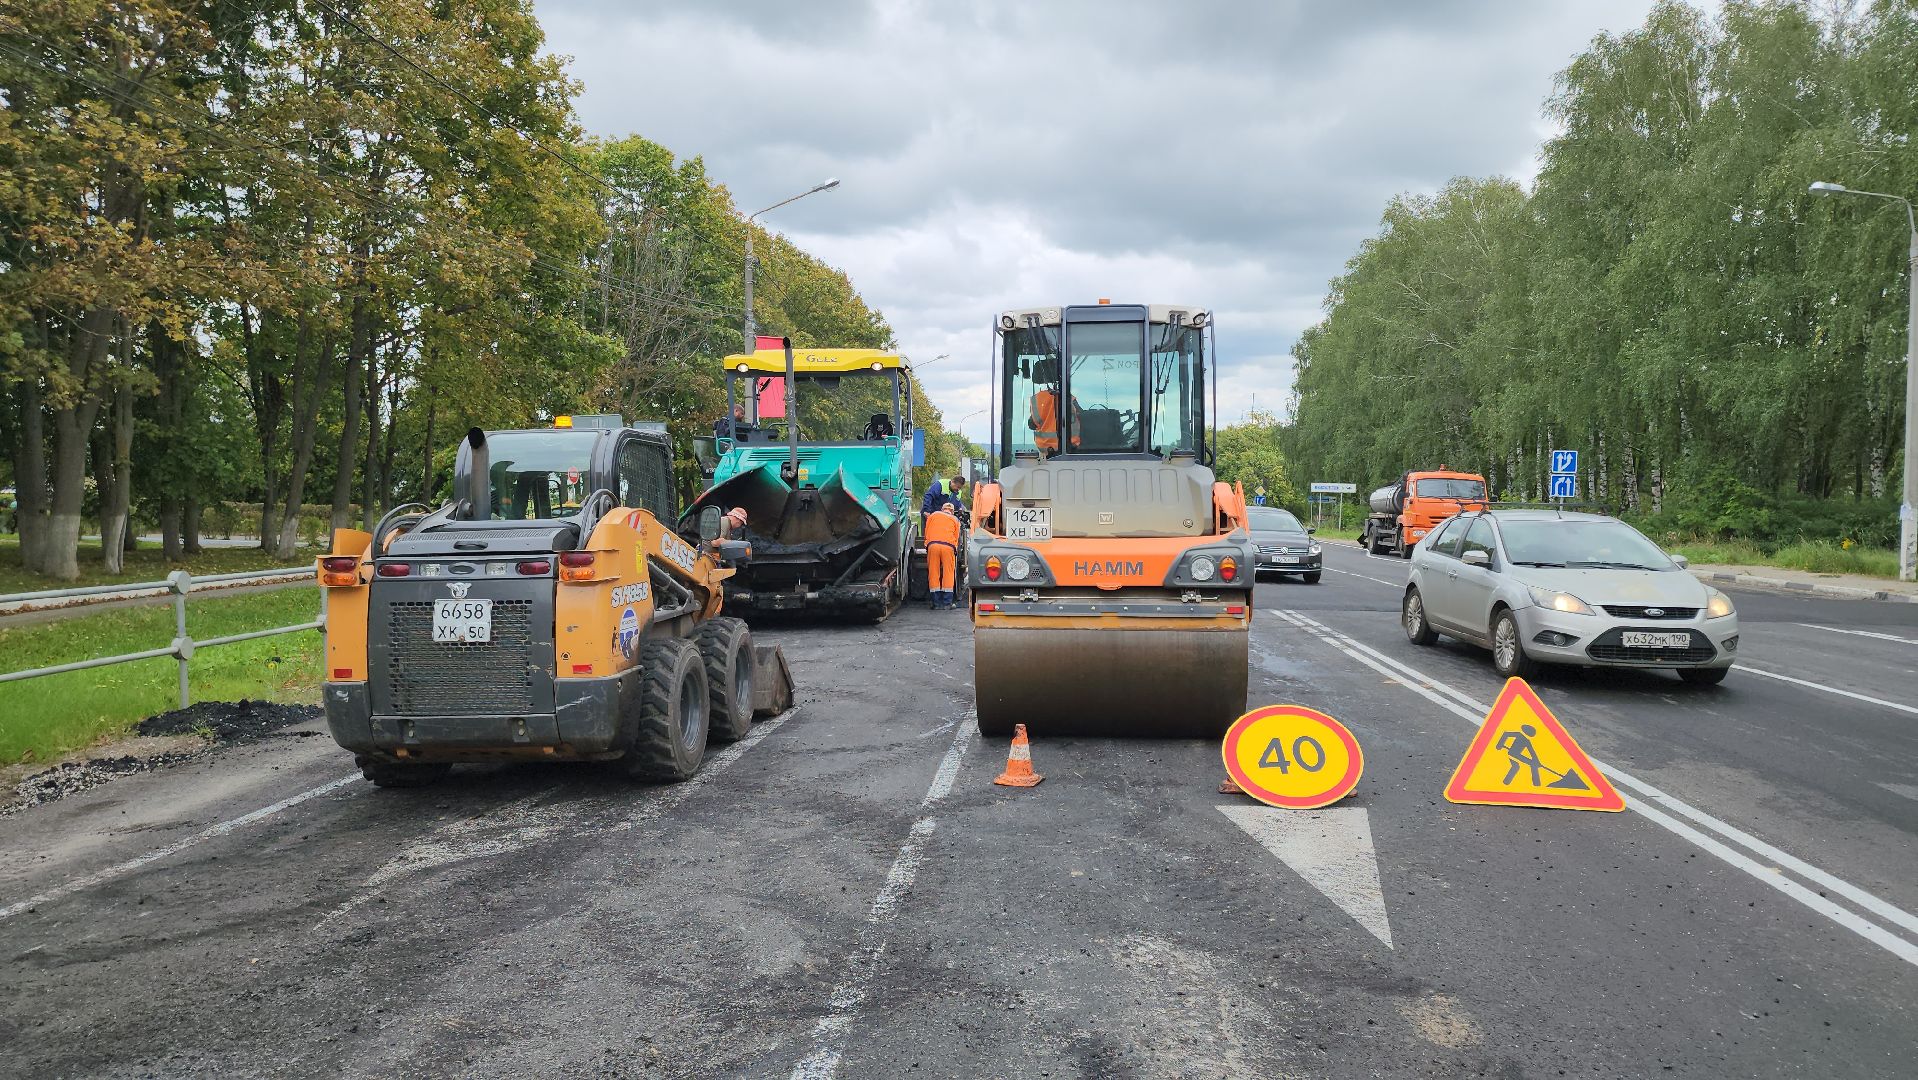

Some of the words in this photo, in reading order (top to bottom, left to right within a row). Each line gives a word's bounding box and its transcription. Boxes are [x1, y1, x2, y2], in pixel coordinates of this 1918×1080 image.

[1013, 510, 1045, 522] 1621
[1034, 528, 1048, 537] 50
[661, 532, 696, 575] CASE
[1074, 561, 1144, 576] HAMM
[441, 603, 483, 619] 6658
[438, 626, 457, 638] ХК
[1672, 634, 1687, 642] 190
[1258, 736, 1326, 774] 40
